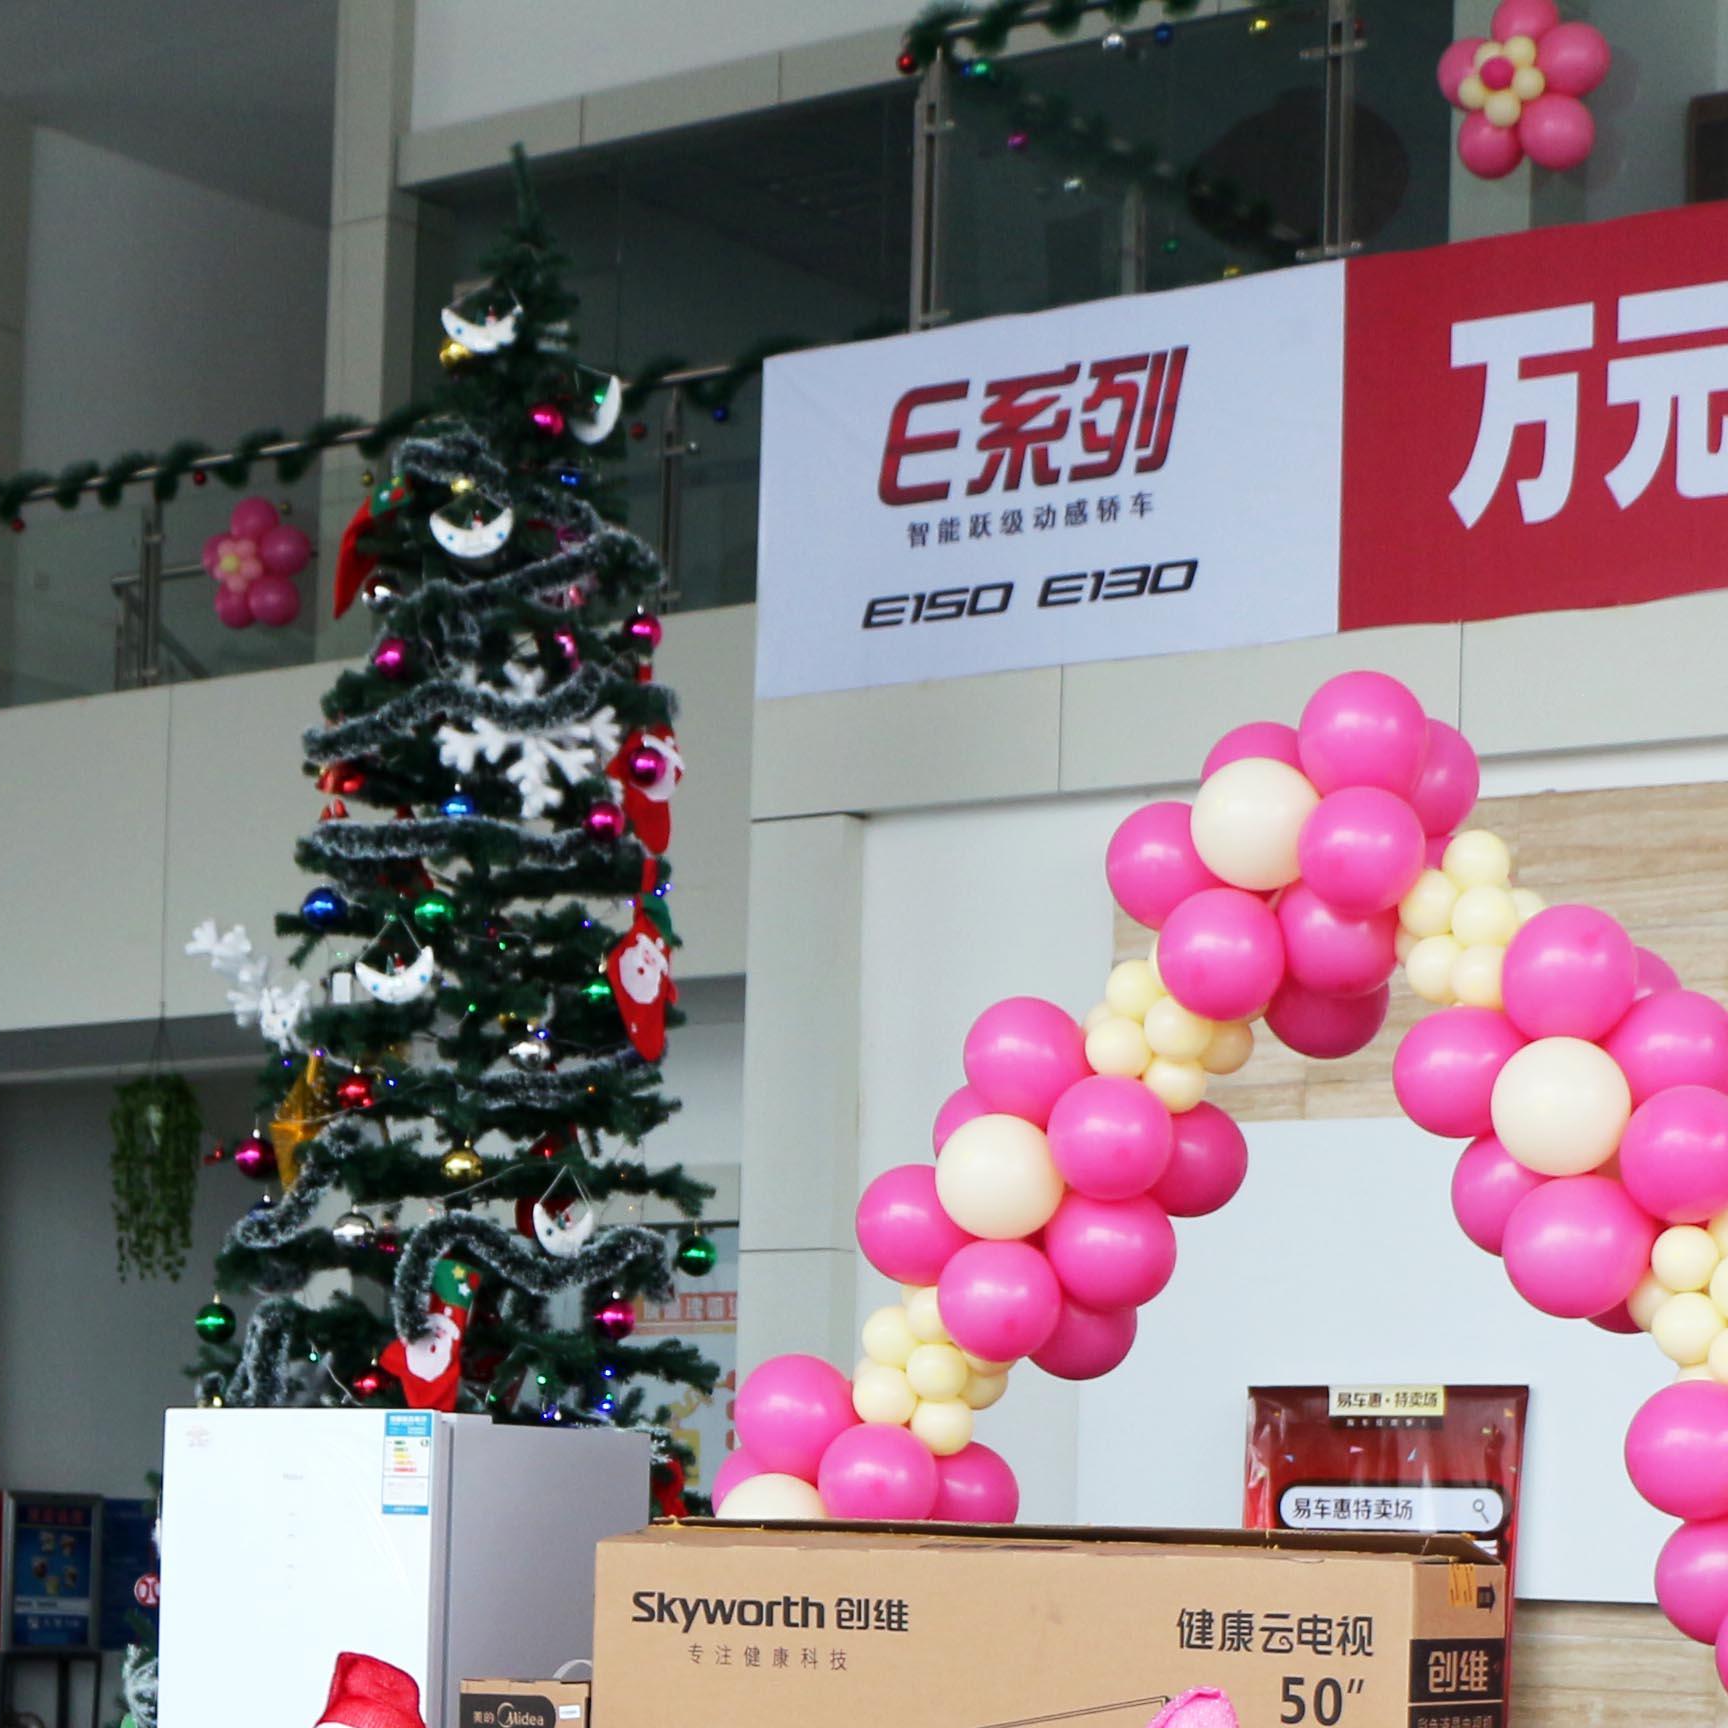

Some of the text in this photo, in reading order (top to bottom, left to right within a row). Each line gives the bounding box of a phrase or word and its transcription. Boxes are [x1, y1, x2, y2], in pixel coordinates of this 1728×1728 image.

[878, 344, 1190, 507] E系列
[906, 490, 1155, 549] 智能跃级动感轿车
[862, 557, 1200, 630] E150 E130
[1293, 1497, 1414, 1521] 易车惠特卖场
[631, 1590, 911, 1635] Skyworth 创维
[1175, 1606, 1375, 1658] 健康云电视
[686, 1642, 849, 1672] 专注健康科技
[1426, 1648, 1491, 1695] 创维
[472, 1702, 545, 1728] 美的 Midea
